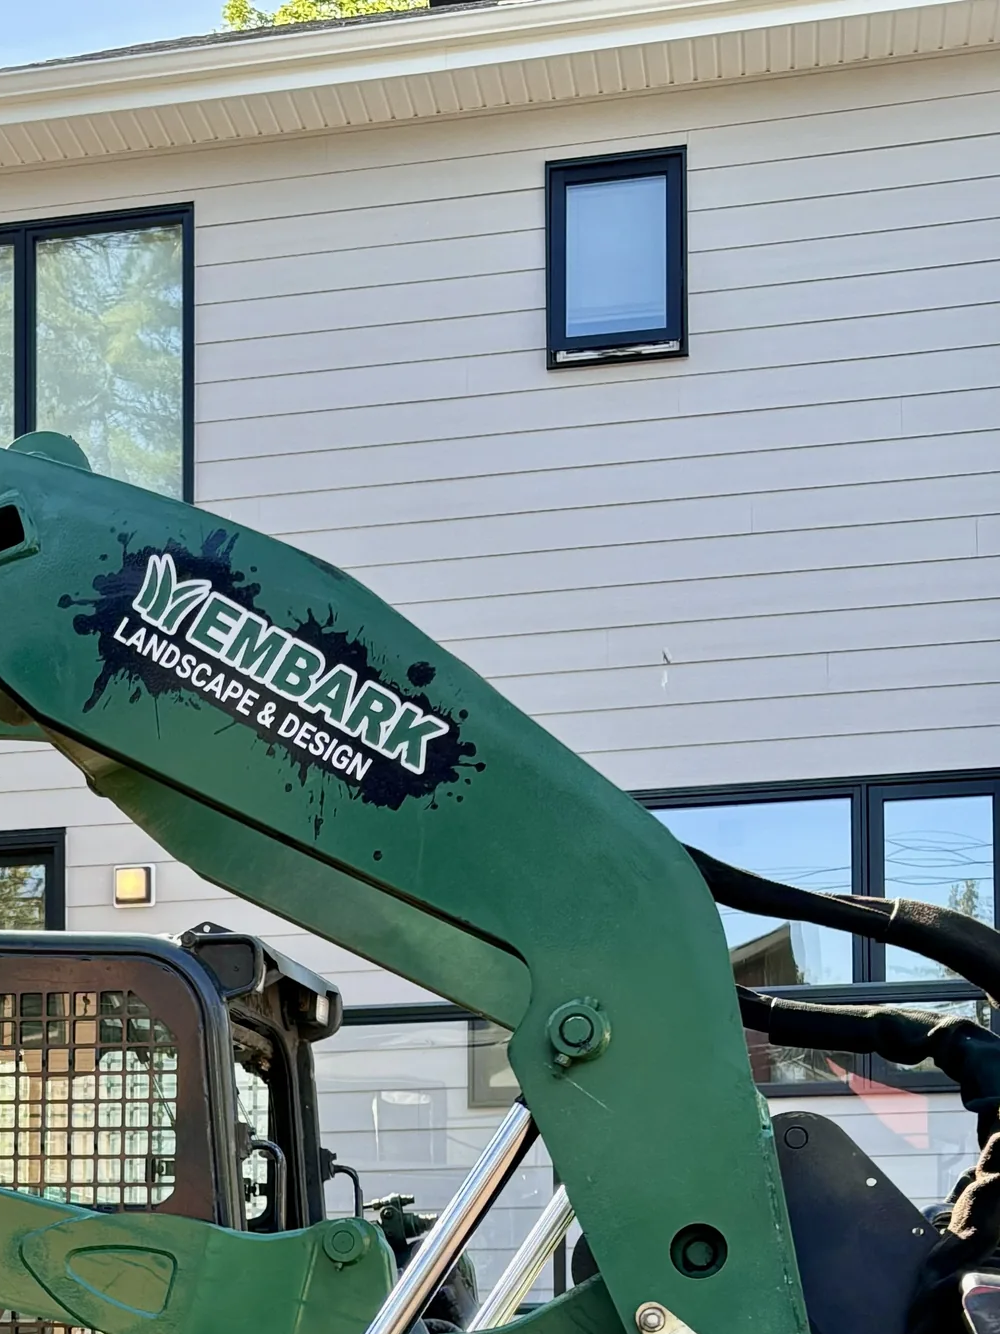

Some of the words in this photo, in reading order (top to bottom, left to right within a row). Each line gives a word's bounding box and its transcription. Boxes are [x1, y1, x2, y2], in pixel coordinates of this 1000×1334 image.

[112, 616, 261, 717] LANDSCAPE
[256, 700, 277, 729] &
[277, 718, 373, 782] DESIGN
[186, 592, 450, 775] EMBARK
